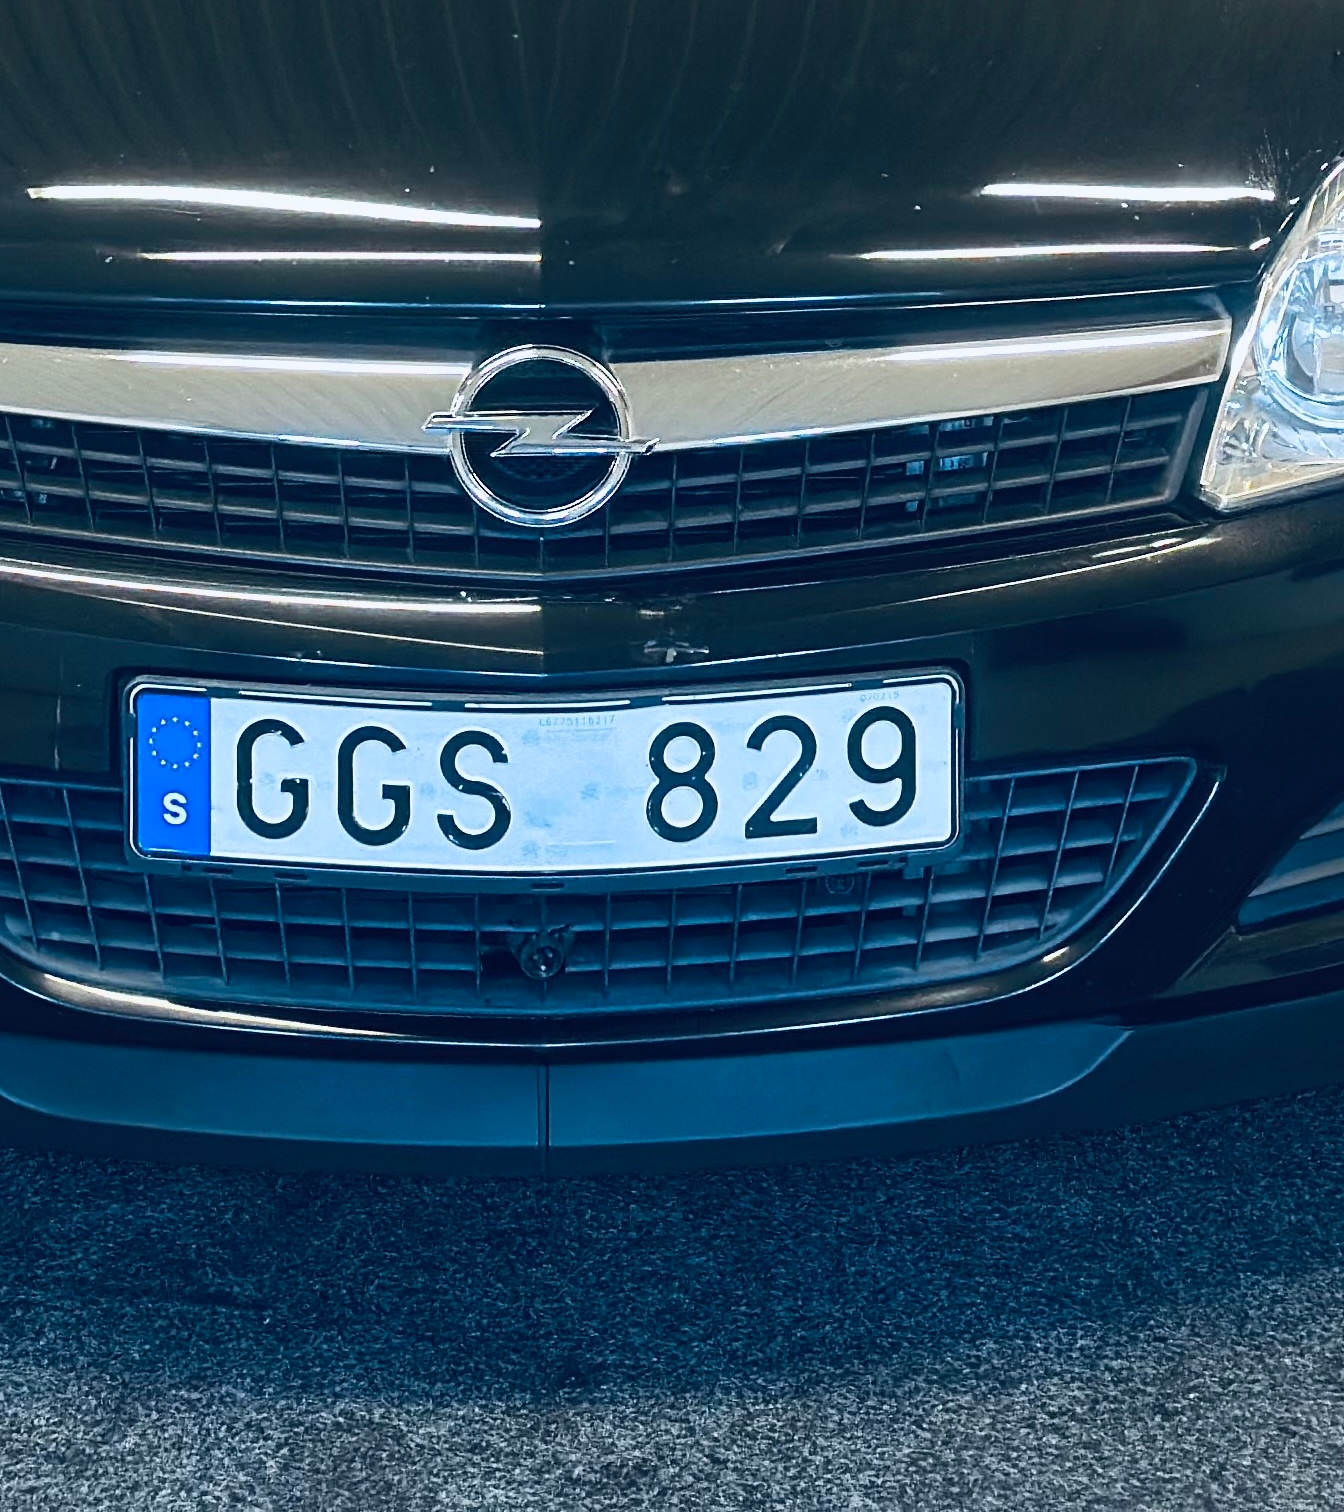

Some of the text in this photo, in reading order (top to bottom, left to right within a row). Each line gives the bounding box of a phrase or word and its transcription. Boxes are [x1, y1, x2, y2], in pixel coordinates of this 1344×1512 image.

[162, 706, 918, 851] S GGS 829
